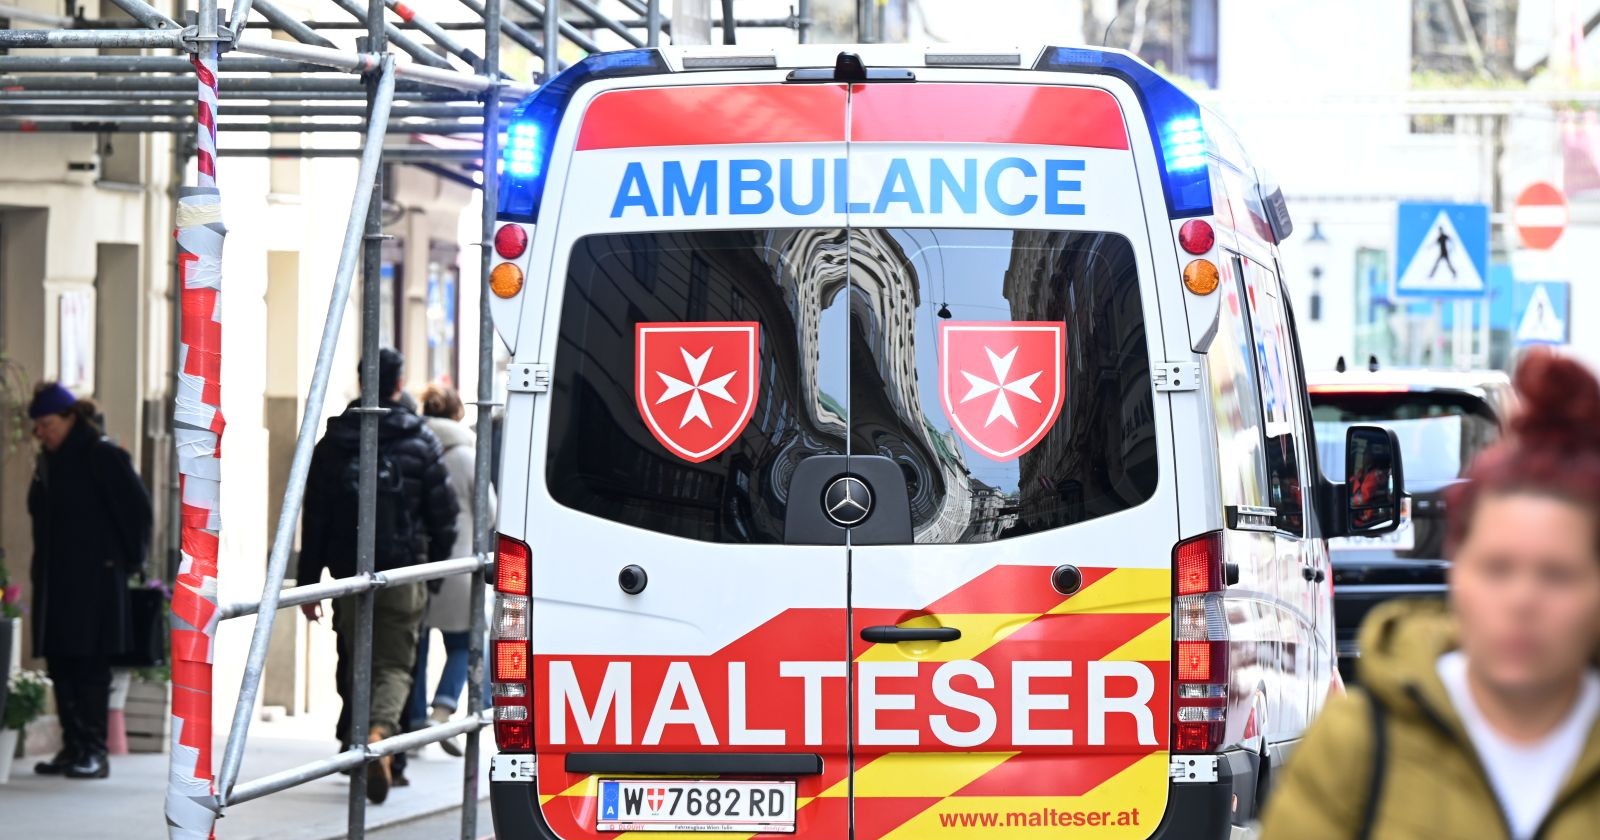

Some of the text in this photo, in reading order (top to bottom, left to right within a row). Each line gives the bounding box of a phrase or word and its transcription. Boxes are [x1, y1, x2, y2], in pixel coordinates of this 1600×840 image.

[609, 157, 1086, 218] AMBULANCE
[548, 659, 1159, 748] MALTESER
[606, 805, 615, 815] A
[624, 787, 785, 817] W 7682 RD
[939, 808, 1140, 828] www.malteser.at
